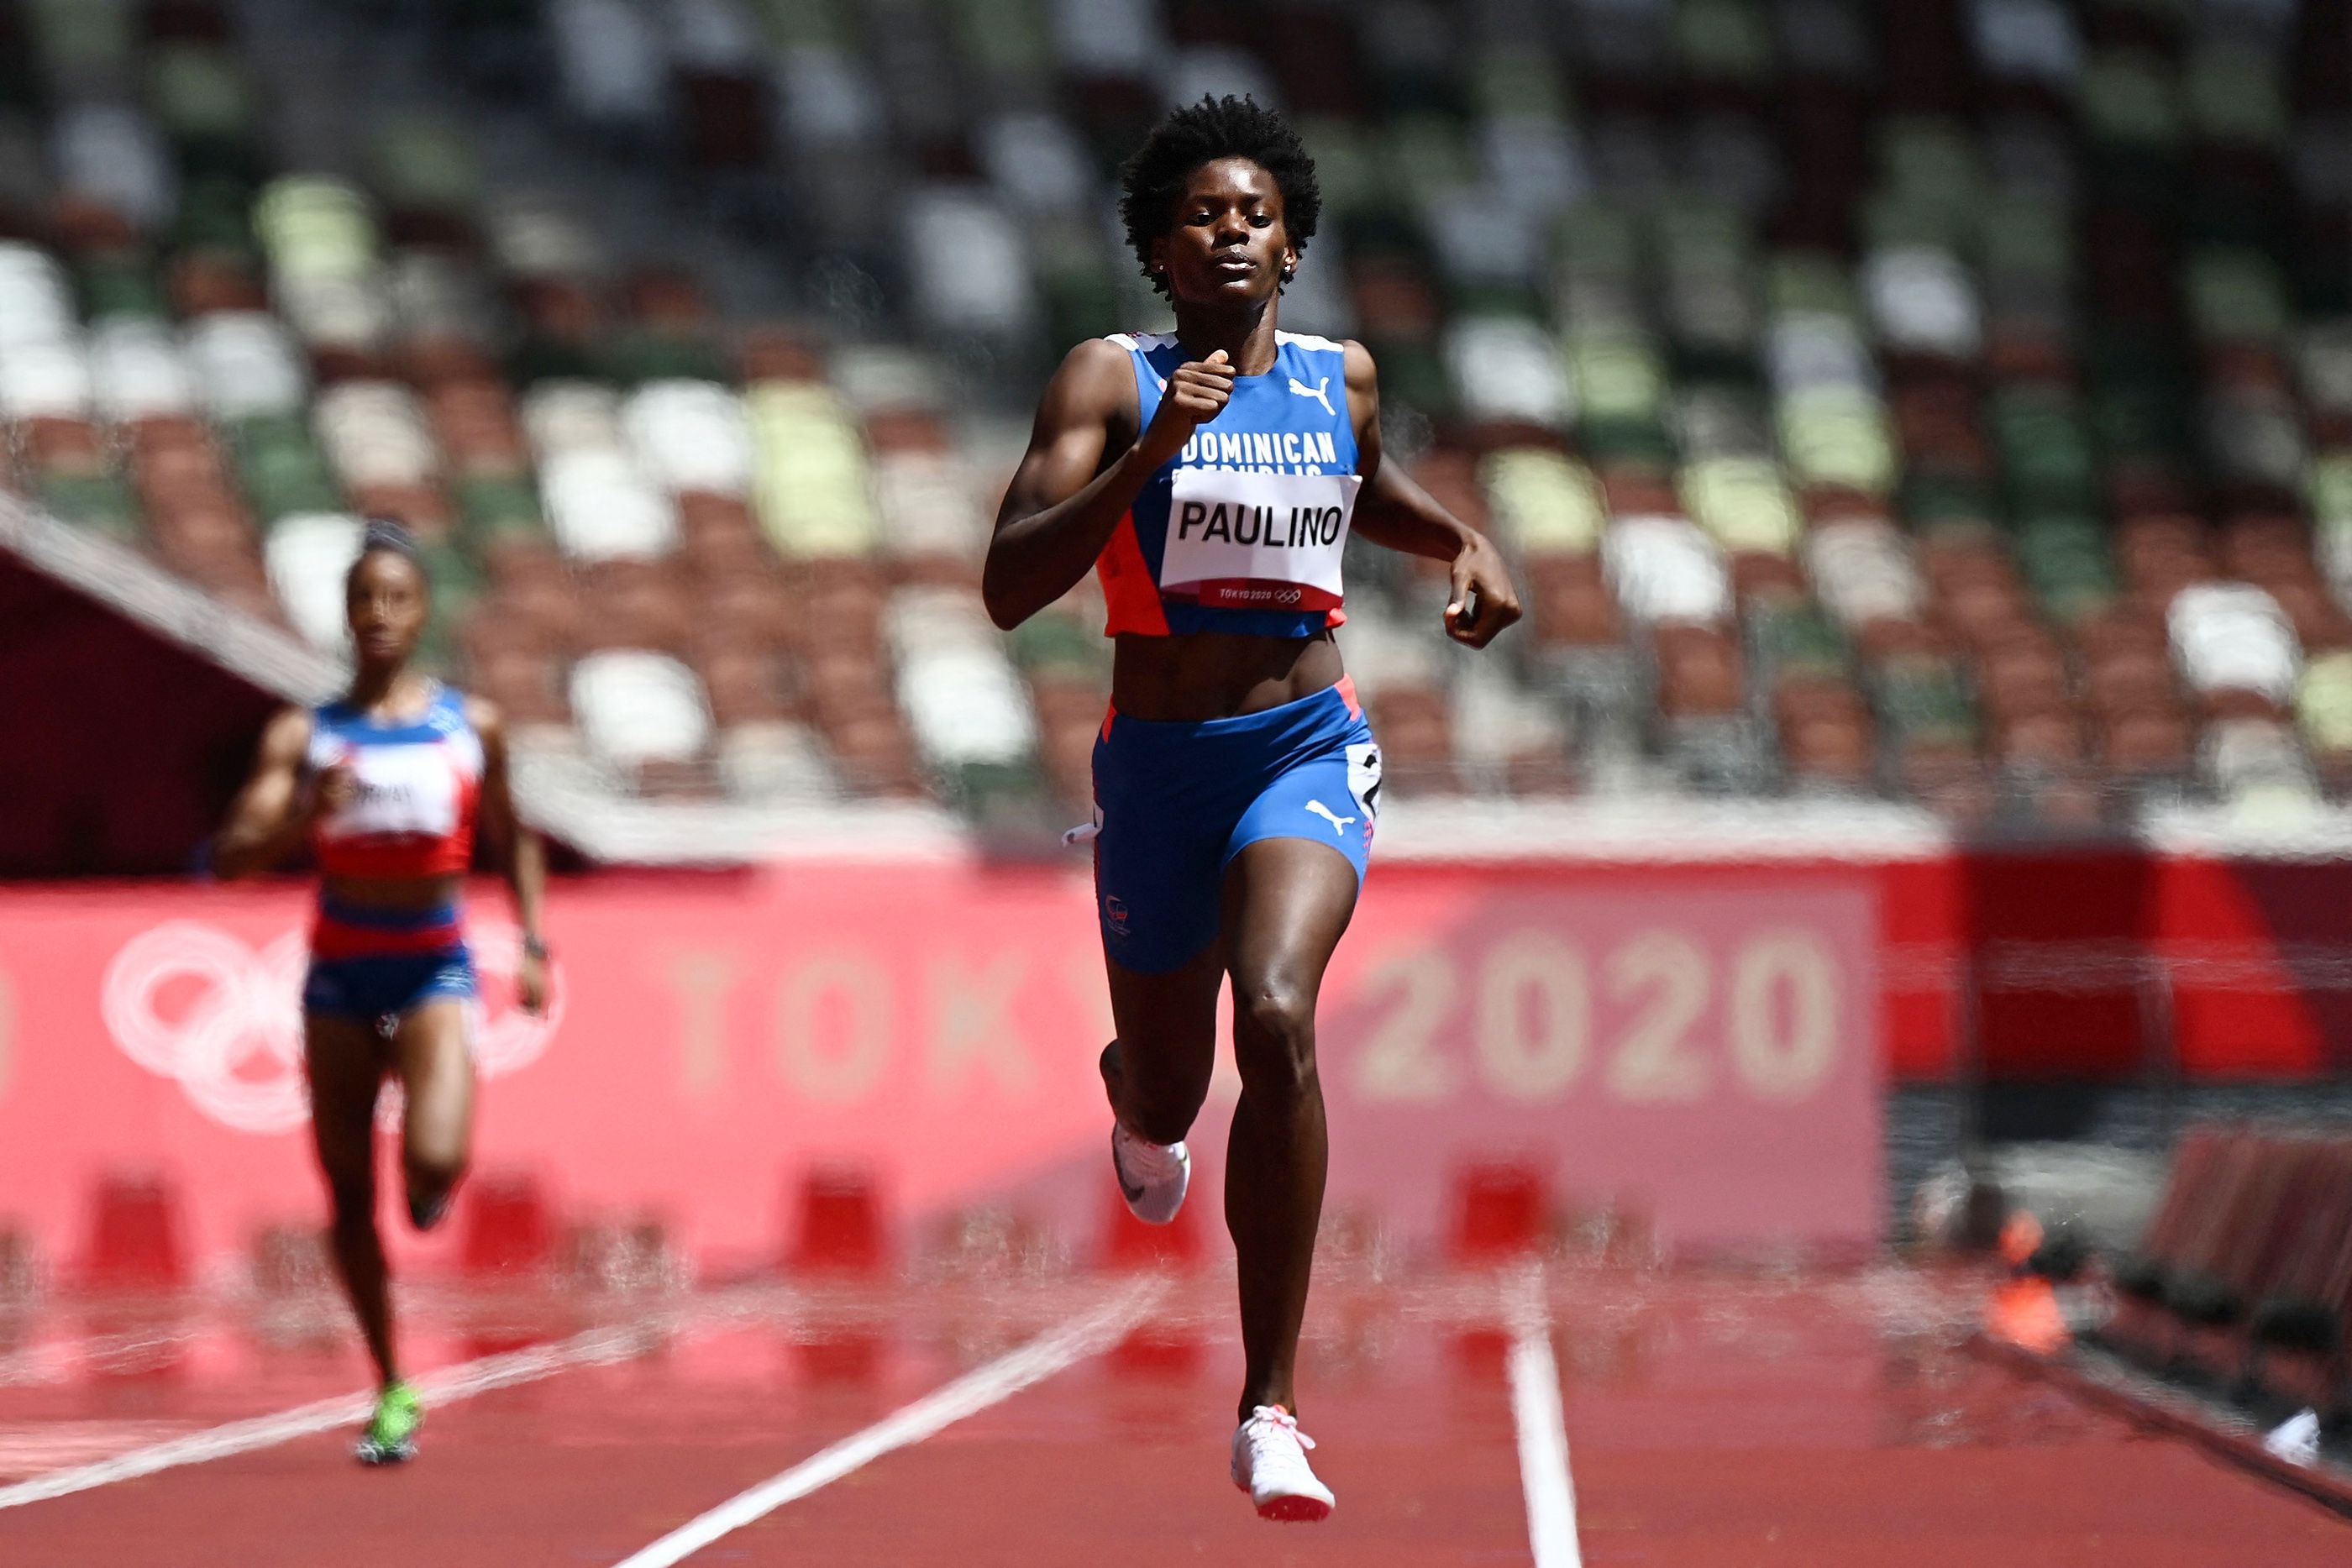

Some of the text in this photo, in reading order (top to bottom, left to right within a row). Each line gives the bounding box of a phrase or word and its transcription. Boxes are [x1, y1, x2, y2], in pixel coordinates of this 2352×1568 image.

[1180, 432, 1336, 464] DOMINICAN
[1178, 501, 1342, 548] PAULINO
[1220, 589, 1272, 600] TOKYO 2020
[659, 930, 1841, 1102] TOK 2020
